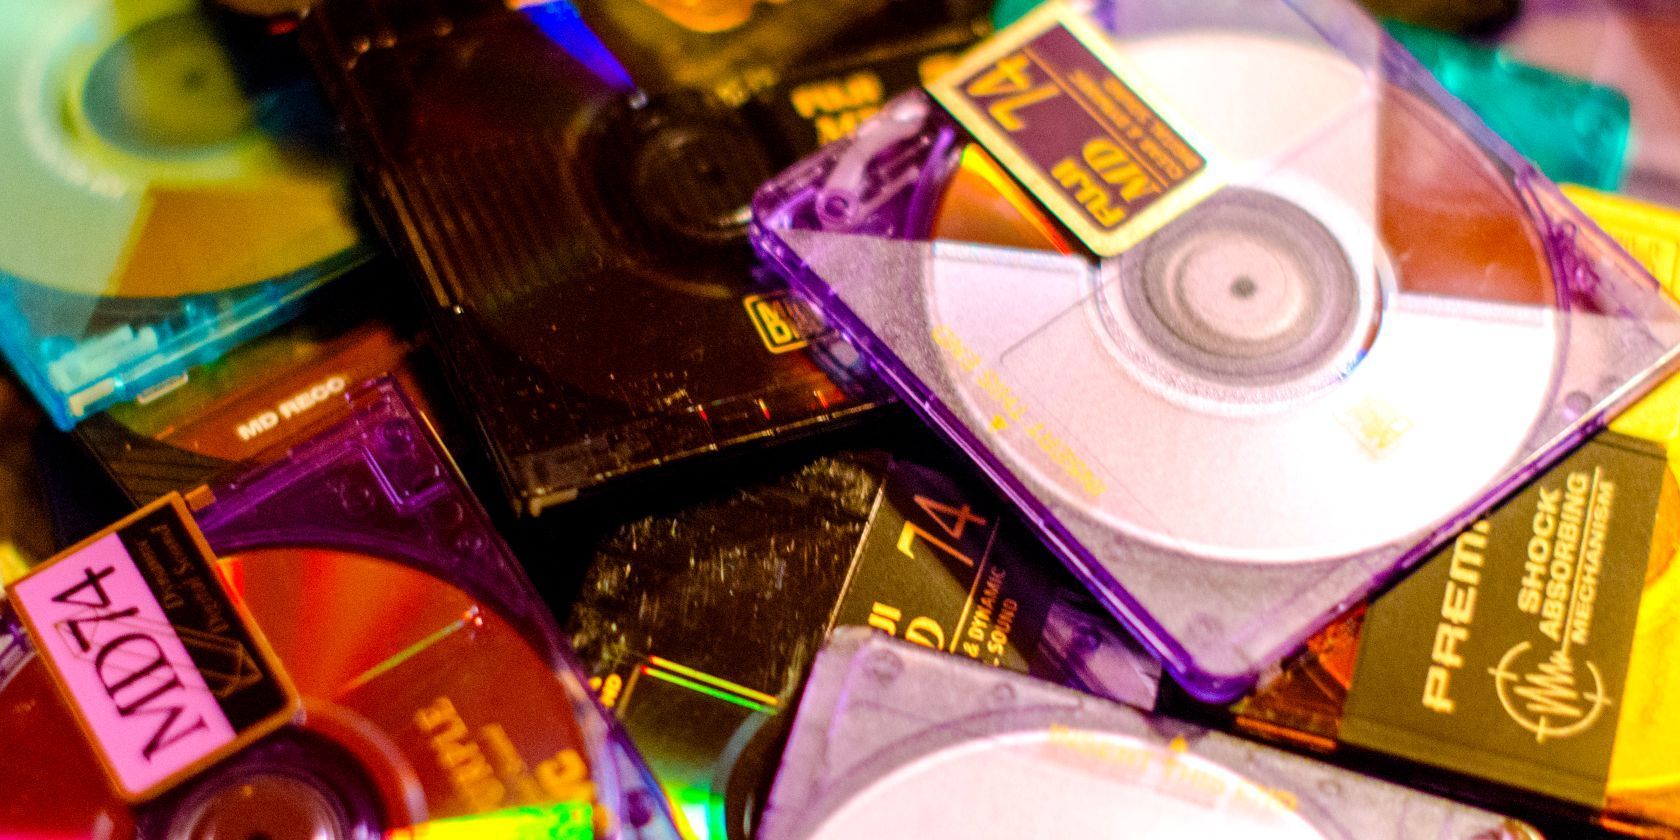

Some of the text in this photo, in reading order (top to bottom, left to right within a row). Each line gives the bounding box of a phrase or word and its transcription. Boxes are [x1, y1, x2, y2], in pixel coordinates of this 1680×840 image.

[966, 54, 1163, 203] MD 74
[1051, 157, 1127, 229] FUJI
[236, 410, 279, 441] MD
[896, 494, 988, 568] 74
[1516, 486, 1562, 615] SHOCK
[1538, 470, 1591, 642] ABSORBING
[1569, 480, 1615, 645] MECHANISM
[867, 601, 902, 637] JI
[905, 615, 945, 651] D
[963, 564, 1007, 658] & DYNAMIC
[986, 597, 1019, 656] SOUND
[50, 565, 211, 763] MD74
